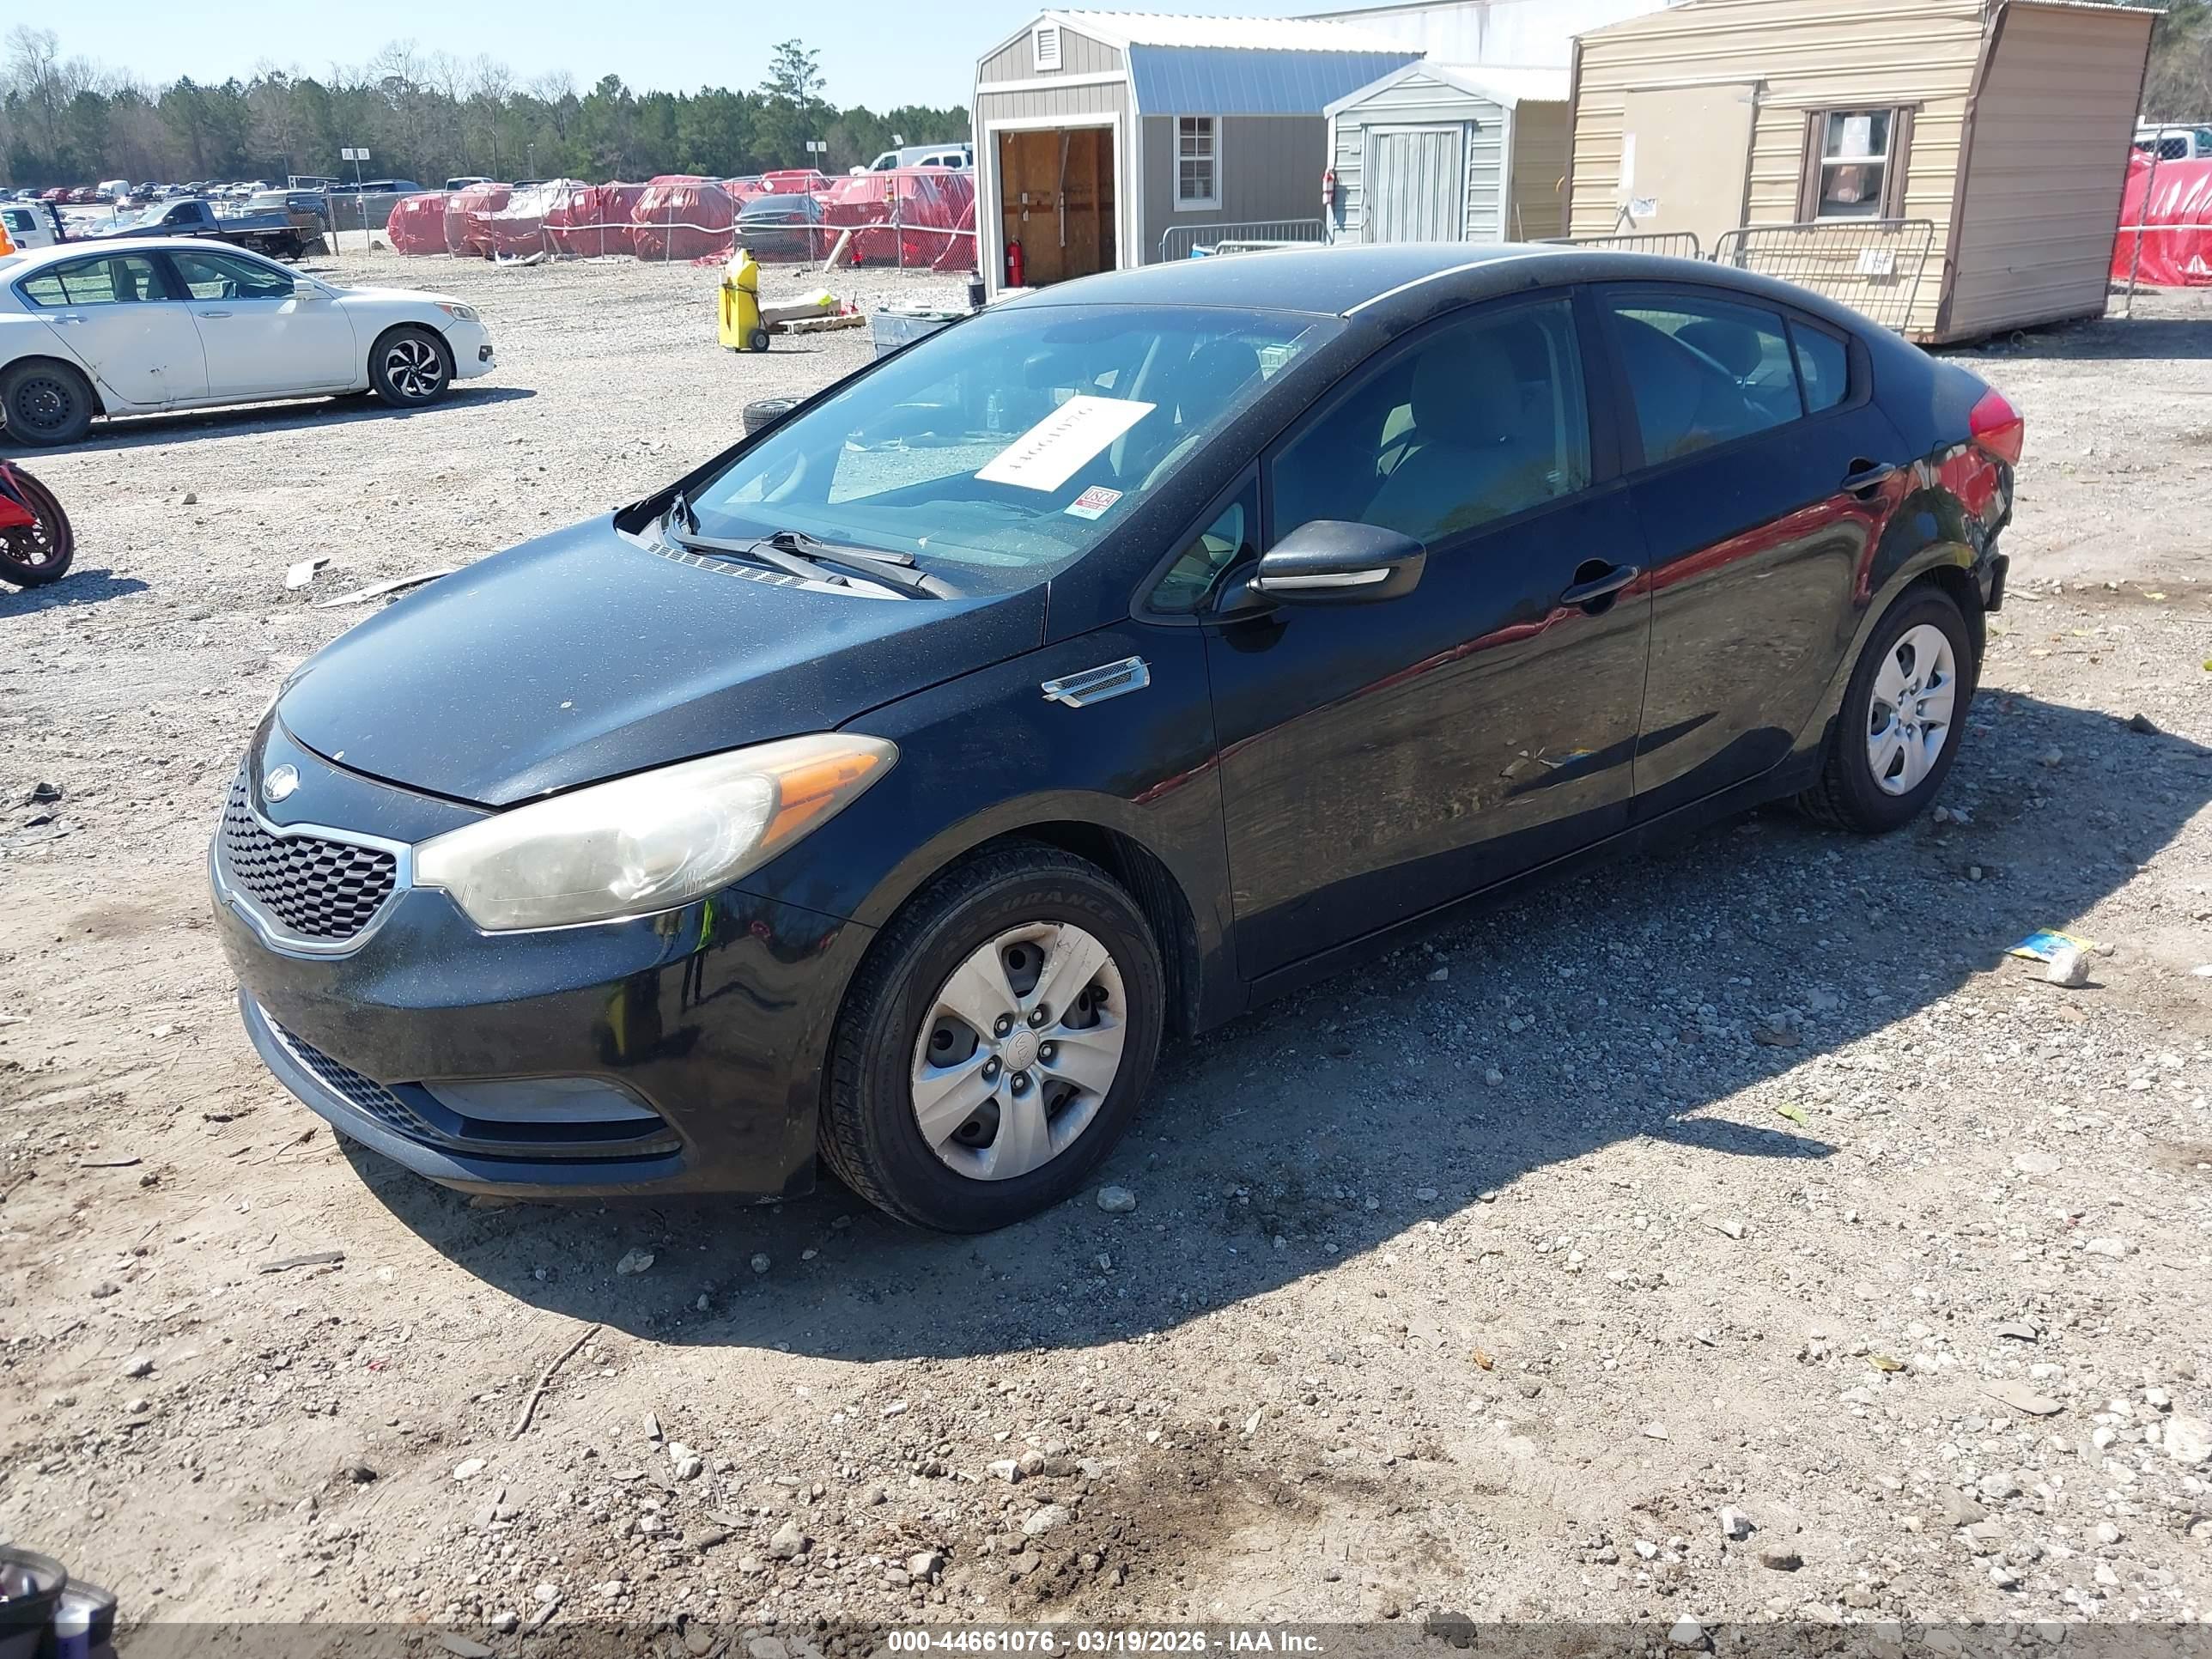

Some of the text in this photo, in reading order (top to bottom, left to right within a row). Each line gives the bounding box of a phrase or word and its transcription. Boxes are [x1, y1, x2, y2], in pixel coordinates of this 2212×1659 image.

[343, 149, 368, 159] A B
[1085, 489, 1115, 505] USCA
